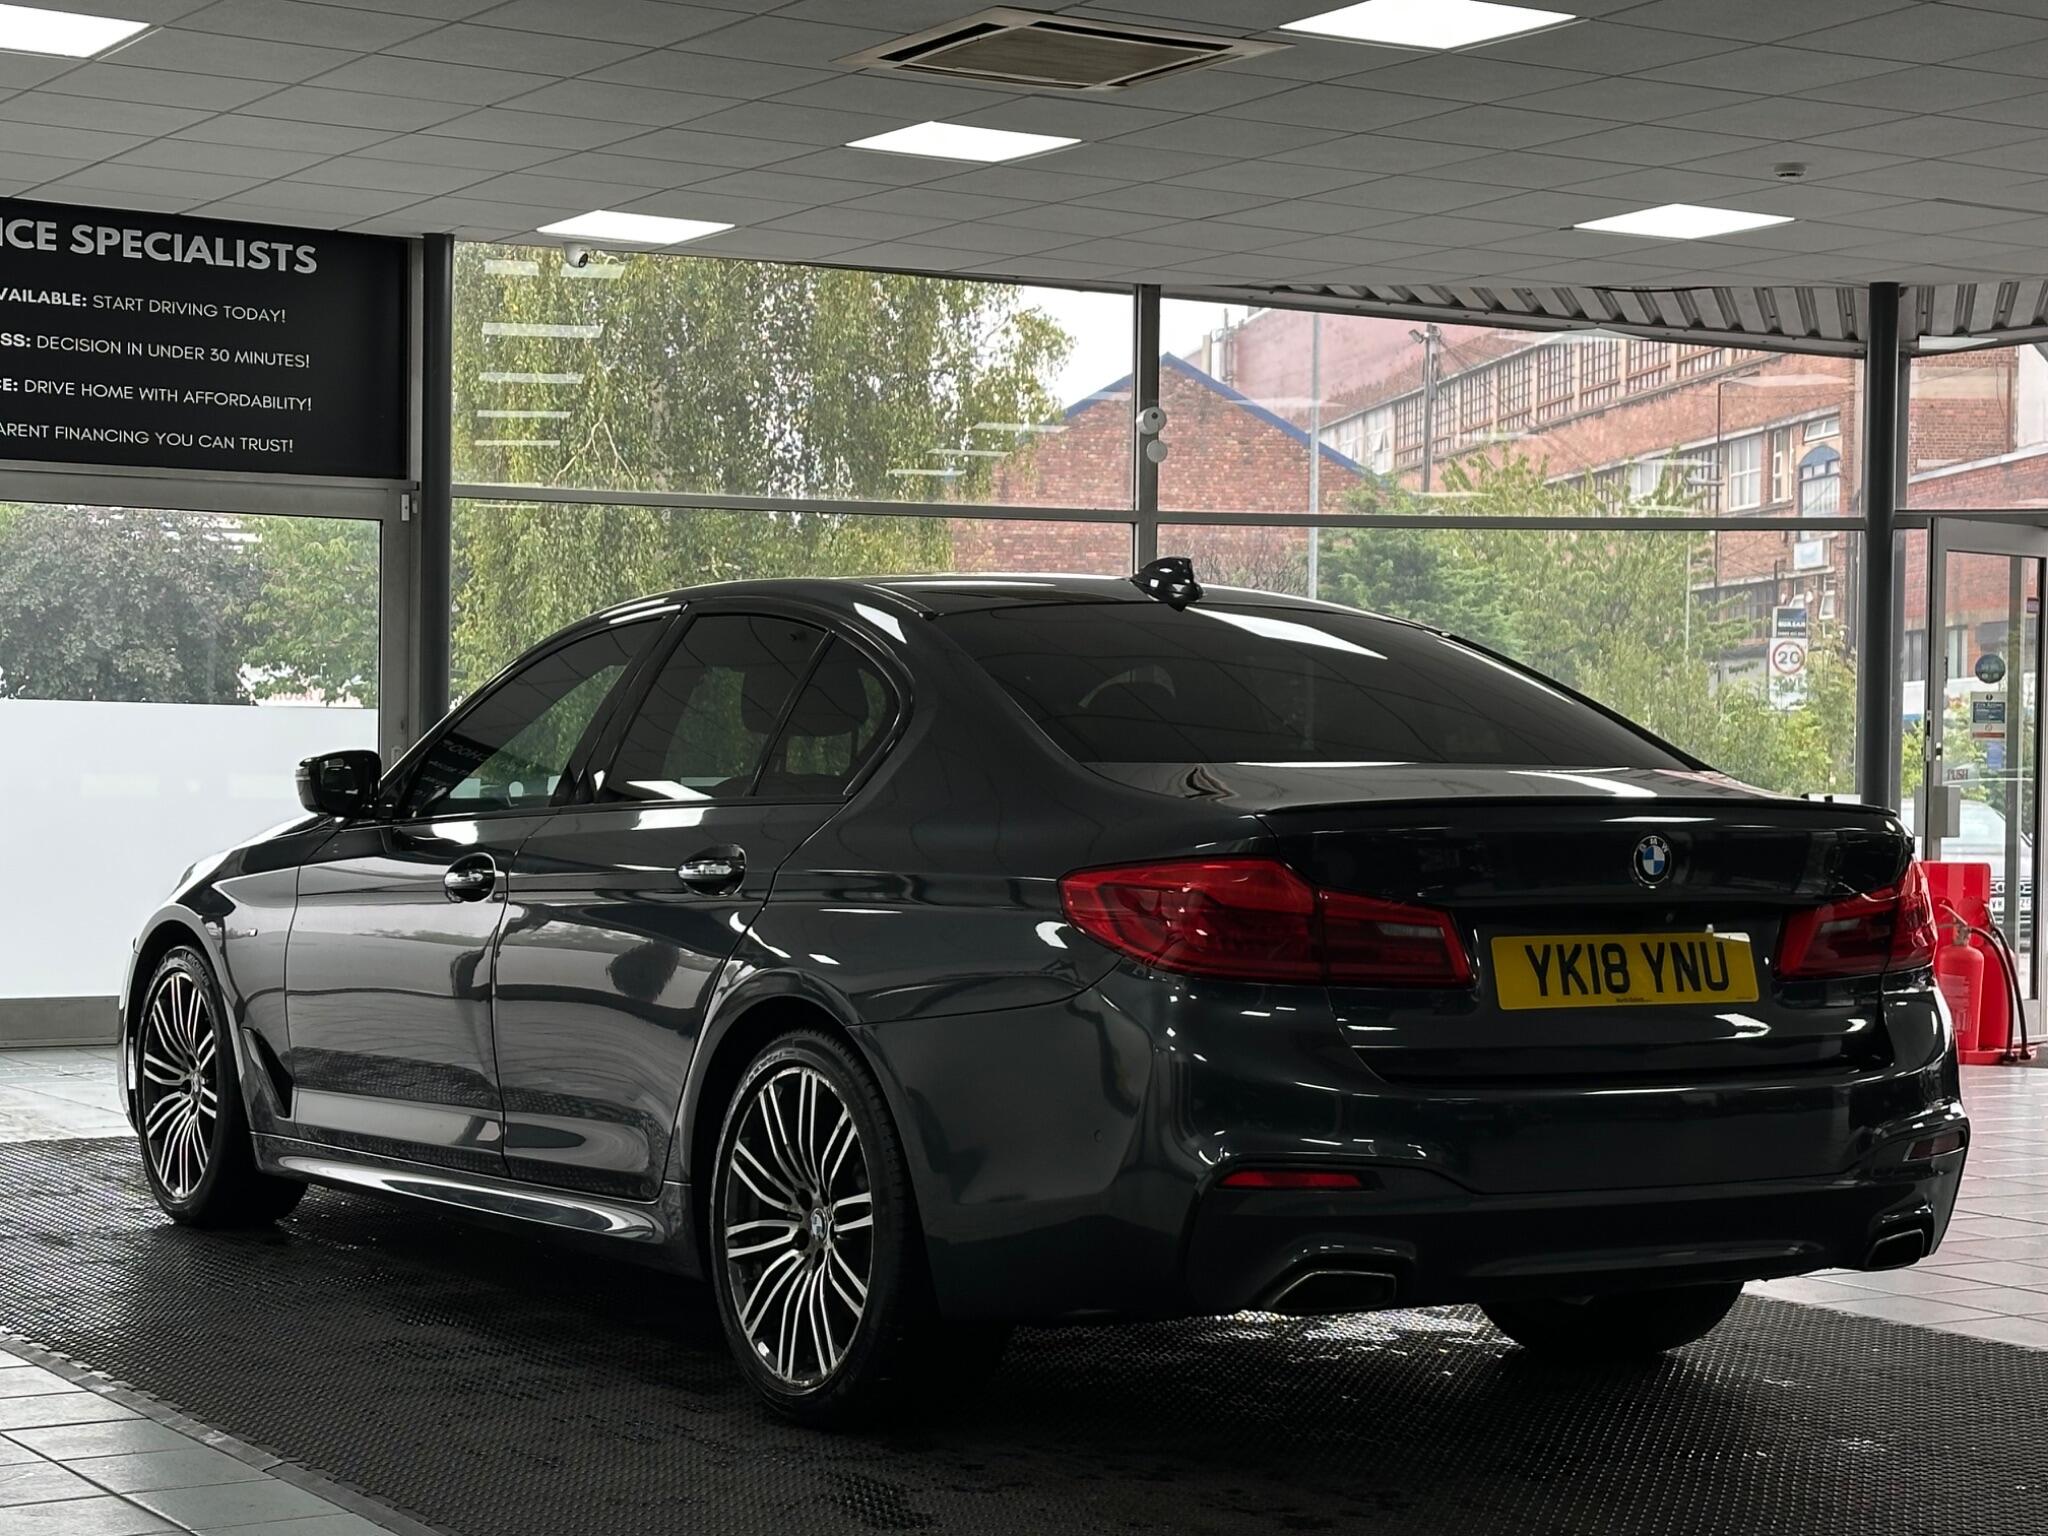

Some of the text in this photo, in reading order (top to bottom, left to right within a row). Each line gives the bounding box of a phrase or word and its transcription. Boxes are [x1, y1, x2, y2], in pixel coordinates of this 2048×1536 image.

[0, 217, 318, 274] CE SPECIALISTS
[93, 295, 143, 311] START
[149, 300, 218, 317] DRIVING
[224, 306, 285, 323] TODAY!
[37, 335, 121, 354] DECISION
[128, 342, 142, 356] IN
[148, 344, 204, 360] UNDER
[210, 348, 229, 362] 30
[235, 351, 309, 368] MINUTES!
[0, 378, 311, 411] E: DRIVE HOME WITH AFFORDABILITY!
[55, 426, 149, 444] FINANCING
[155, 433, 192, 446] YOU
[199, 435, 234, 449] CAN
[240, 437, 292, 452] TRUST!
[1778, 651, 1801, 665] 20
[1524, 941, 1729, 996] YK18 YNU
